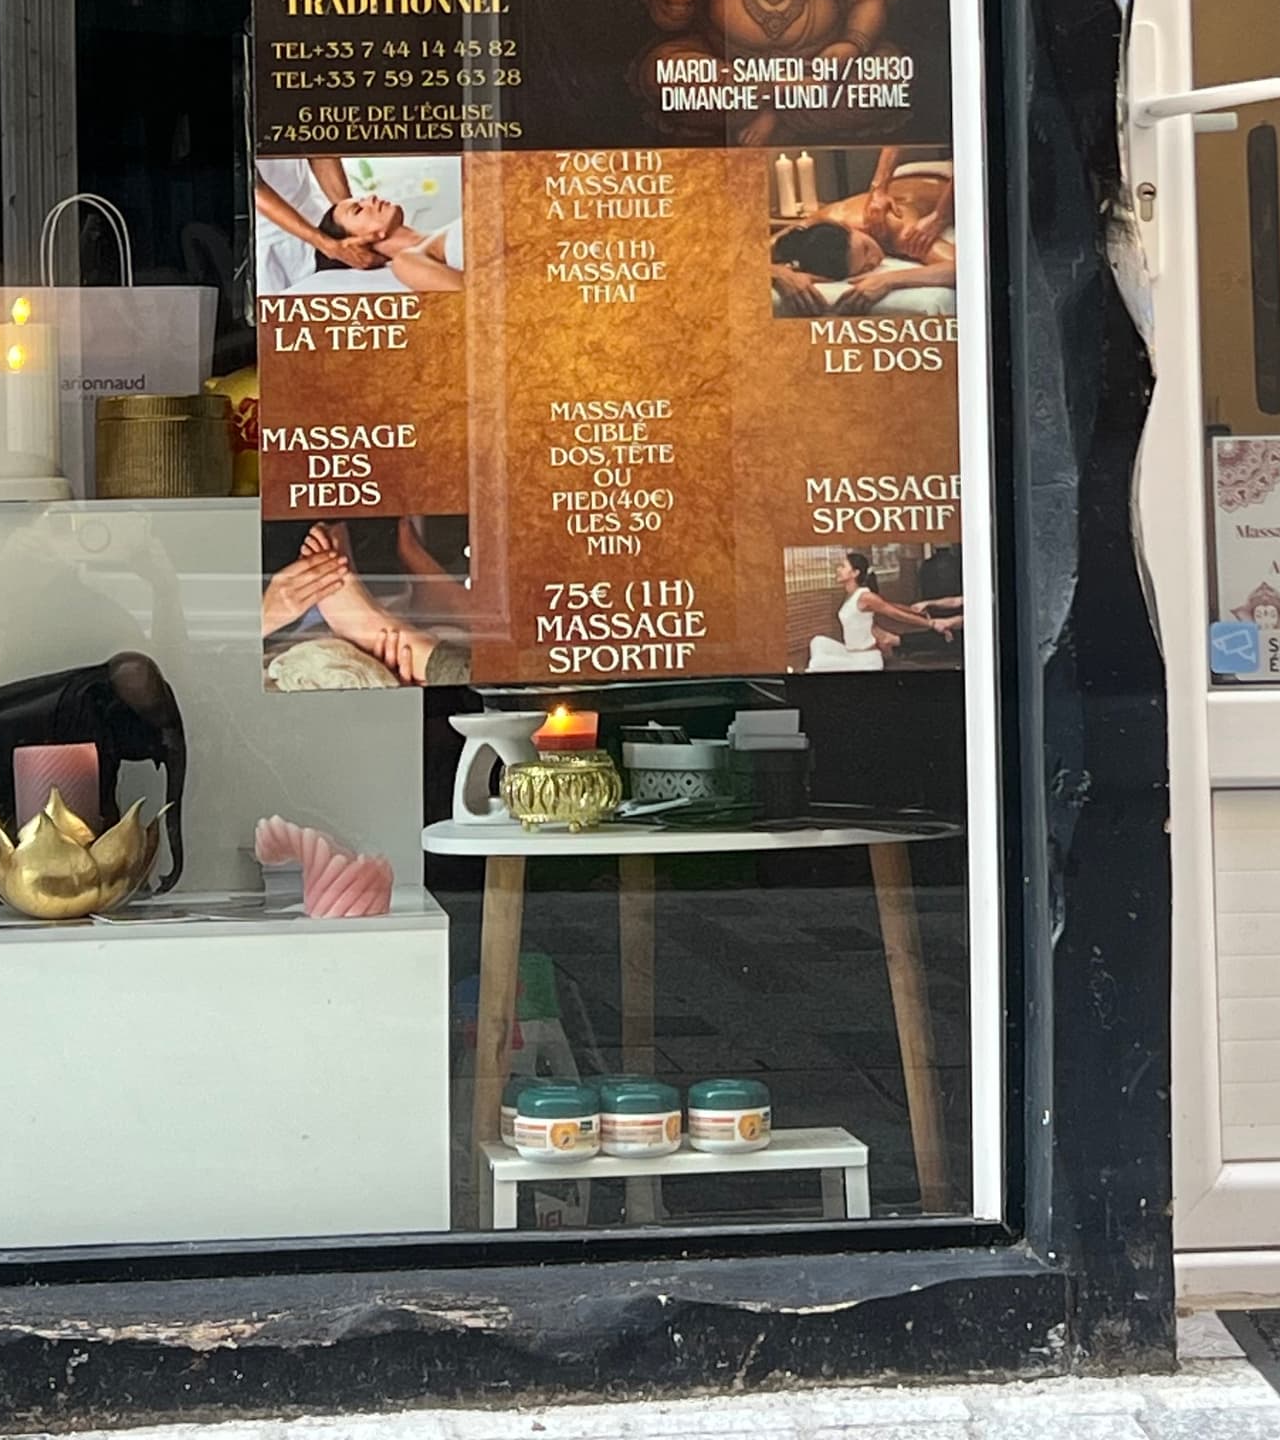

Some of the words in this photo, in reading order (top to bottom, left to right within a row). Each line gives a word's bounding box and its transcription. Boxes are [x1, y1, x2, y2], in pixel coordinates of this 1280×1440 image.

[270, 41, 354, 60] TEL+33
[360, 41, 374, 58] 7
[382, 40, 411, 58] 44
[421, 40, 446, 58] 14
[453, 39, 482, 58] 45
[488, 39, 517, 57] 82
[271, 71, 356, 89] TEL+33
[362, 70, 377, 88] 7
[383, 69, 414, 88] 59
[421, 69, 450, 87] 25
[456, 68, 486, 87] 63
[493, 68, 522, 86] 28
[656, 59, 717, 84] MARDI
[733, 58, 803, 83] SAMEDI
[811, 58, 838, 82] 9H
[661, 85, 758, 111] DIMANCHE
[774, 85, 828, 109] LUNDI
[831, 84, 843, 109] /
[298, 106, 313, 123] 6
[319, 105, 361, 123] RUE
[367, 105, 396, 122] DE
[402, 101, 494, 121] L'ÉGLISE
[271, 125, 339, 142] 74500
[346, 121, 408, 141] ÉVIAN
[415, 122, 454, 140] LES
[460, 122, 522, 139] BAINS
[555, 151, 663, 174] 70€(1H)
[545, 174, 675, 196] MASSAGE
[546, 194, 565, 220] À
[574, 198, 674, 220] L'HUILE
[556, 240, 656, 261] 70€(1H)
[546, 261, 668, 282] MASSAGE
[578, 284, 637, 304] THAI
[260, 295, 422, 323] MASSAGE
[275, 327, 317, 351] LA
[325, 321, 409, 351] TÊTE
[810, 318, 958, 344] MASSAGE
[824, 349, 864, 373] LE
[872, 347, 943, 372] DOS
[550, 399, 673, 422] MASSAGE
[261, 424, 417, 452] MASSAGE
[574, 417, 648, 443] CIBLÉ
[308, 454, 372, 479] DES
[593, 468, 632, 487] OU
[289, 482, 381, 508] PIEDS
[552, 489, 674, 511] PIED(40€)
[567, 513, 621, 536] (LES
[629, 512, 662, 532] 30
[813, 505, 955, 534] SPORTIF
[587, 535, 641, 556] MIN)
[544, 581, 614, 610] 75€
[625, 579, 695, 612] (1H)
[536, 610, 707, 642] MASSAGE
[548, 642, 695, 674] SPORTIF
